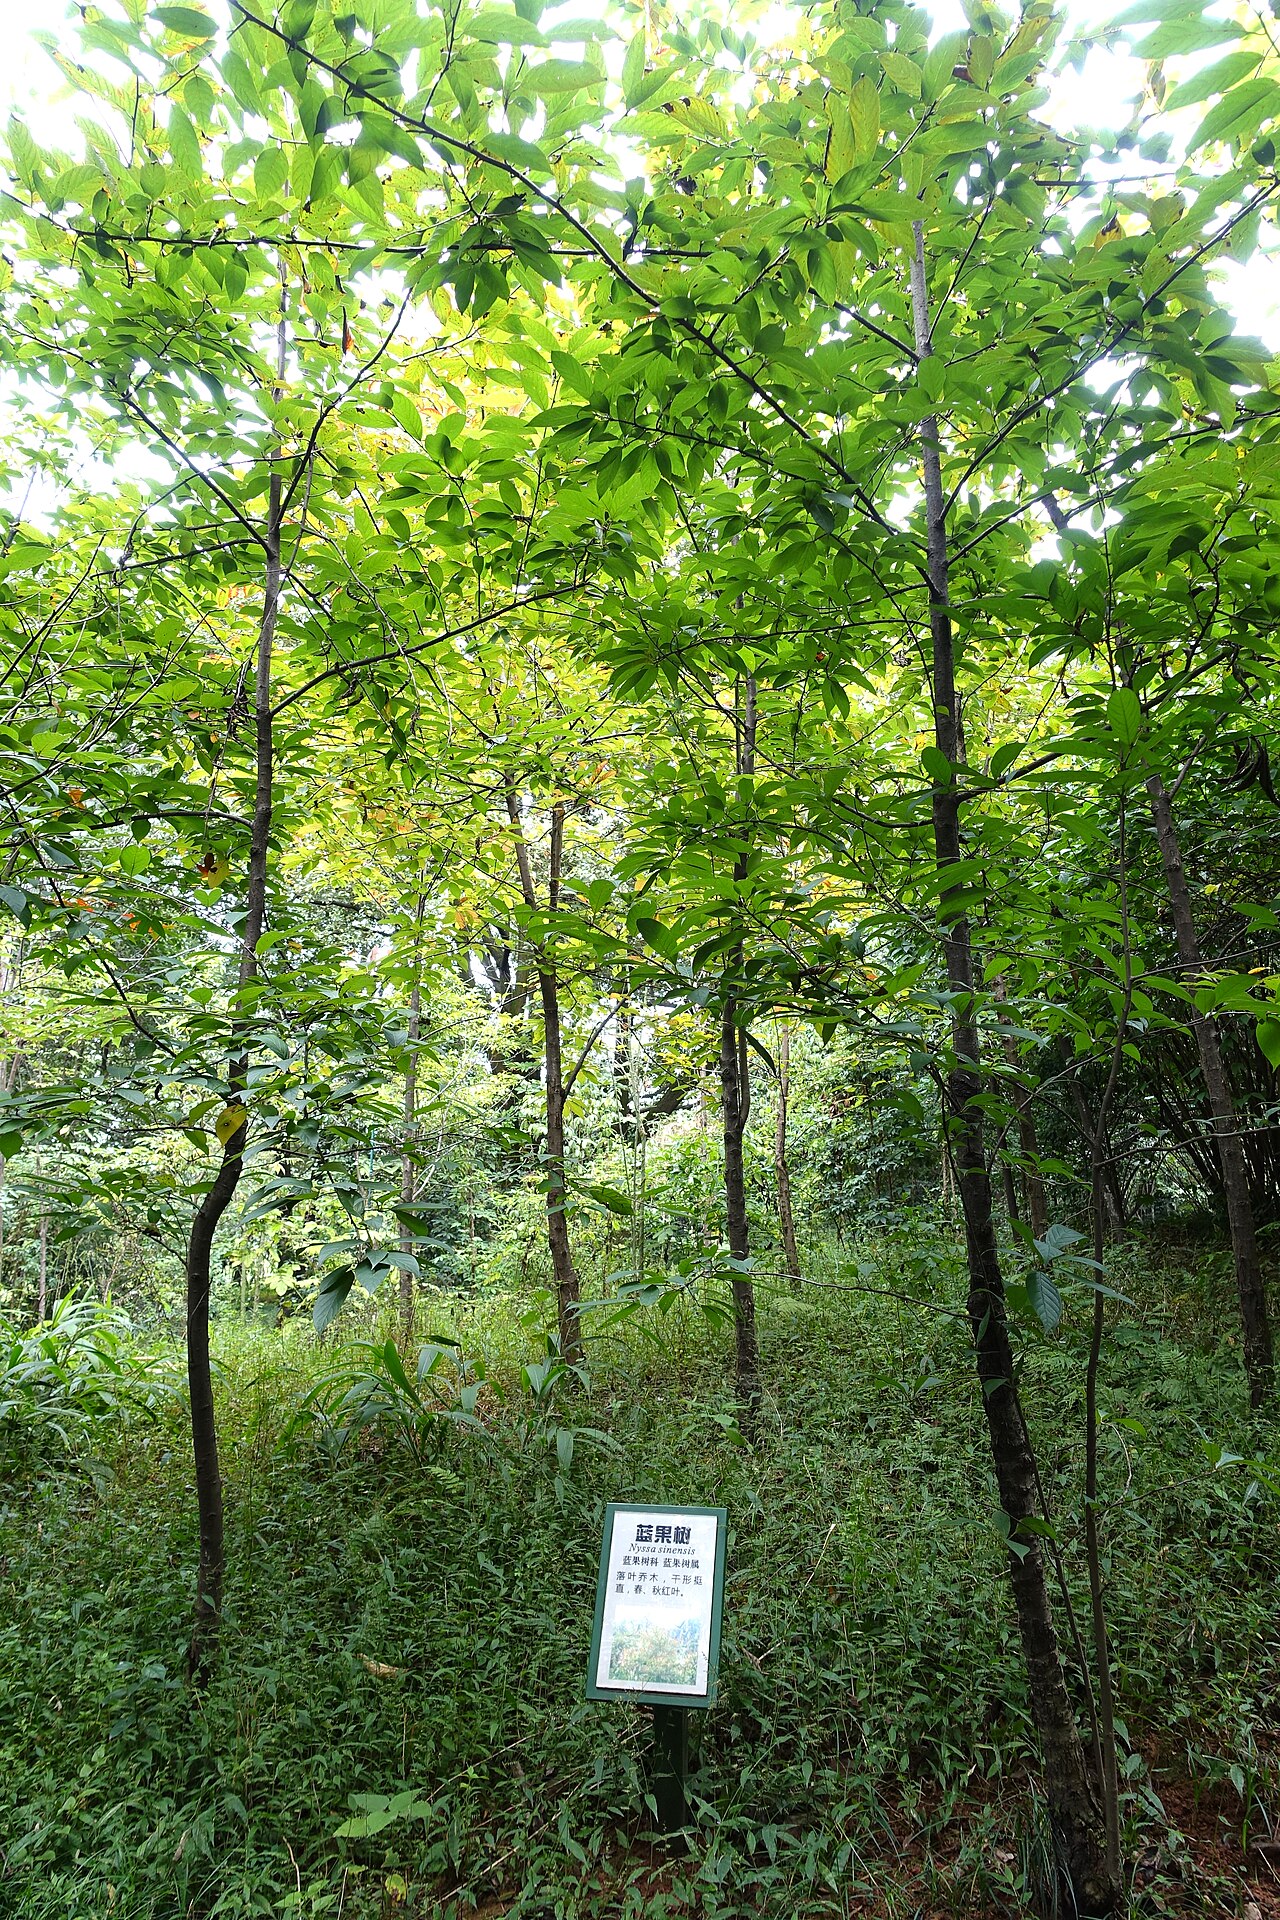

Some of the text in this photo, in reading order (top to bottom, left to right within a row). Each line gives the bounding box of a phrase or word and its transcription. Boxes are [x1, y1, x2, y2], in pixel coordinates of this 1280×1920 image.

[635, 1524, 692, 1545] 蓝果树
[628, 1543, 696, 1555] Nyssa sinensis
[622, 1555, 700, 1569] 蓝果树科 蓝果树属
